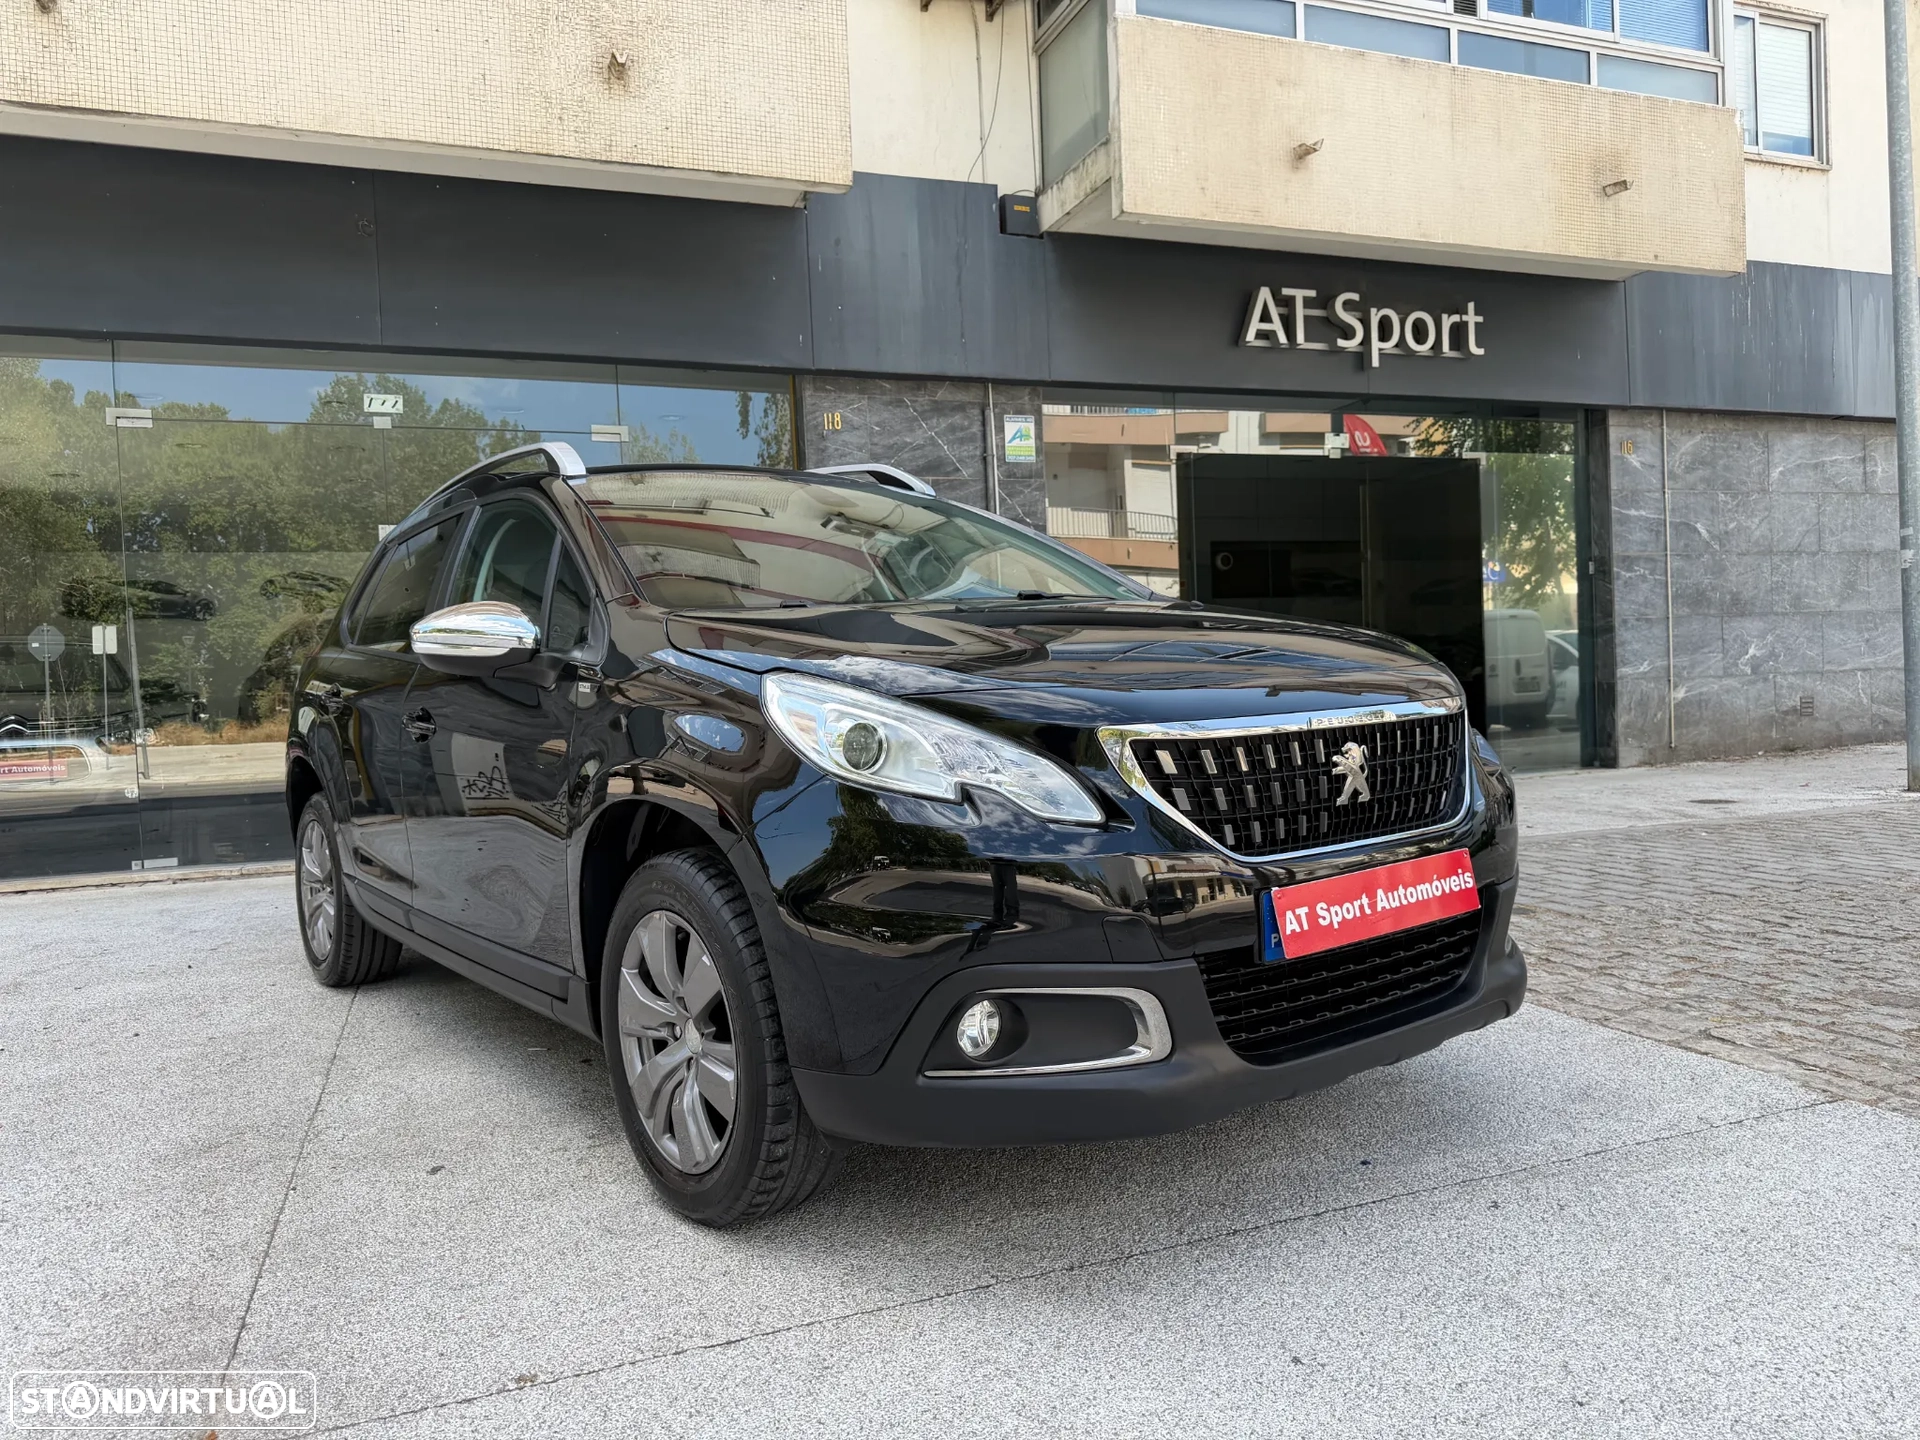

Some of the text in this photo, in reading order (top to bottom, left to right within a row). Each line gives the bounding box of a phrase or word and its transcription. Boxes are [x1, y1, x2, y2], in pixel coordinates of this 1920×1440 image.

[1245, 286, 1485, 367] AT Sport
[823, 412, 842, 430] 118
[1622, 440, 1633, 454] 116
[1285, 868, 1474, 935] AT Sport Automóveis
